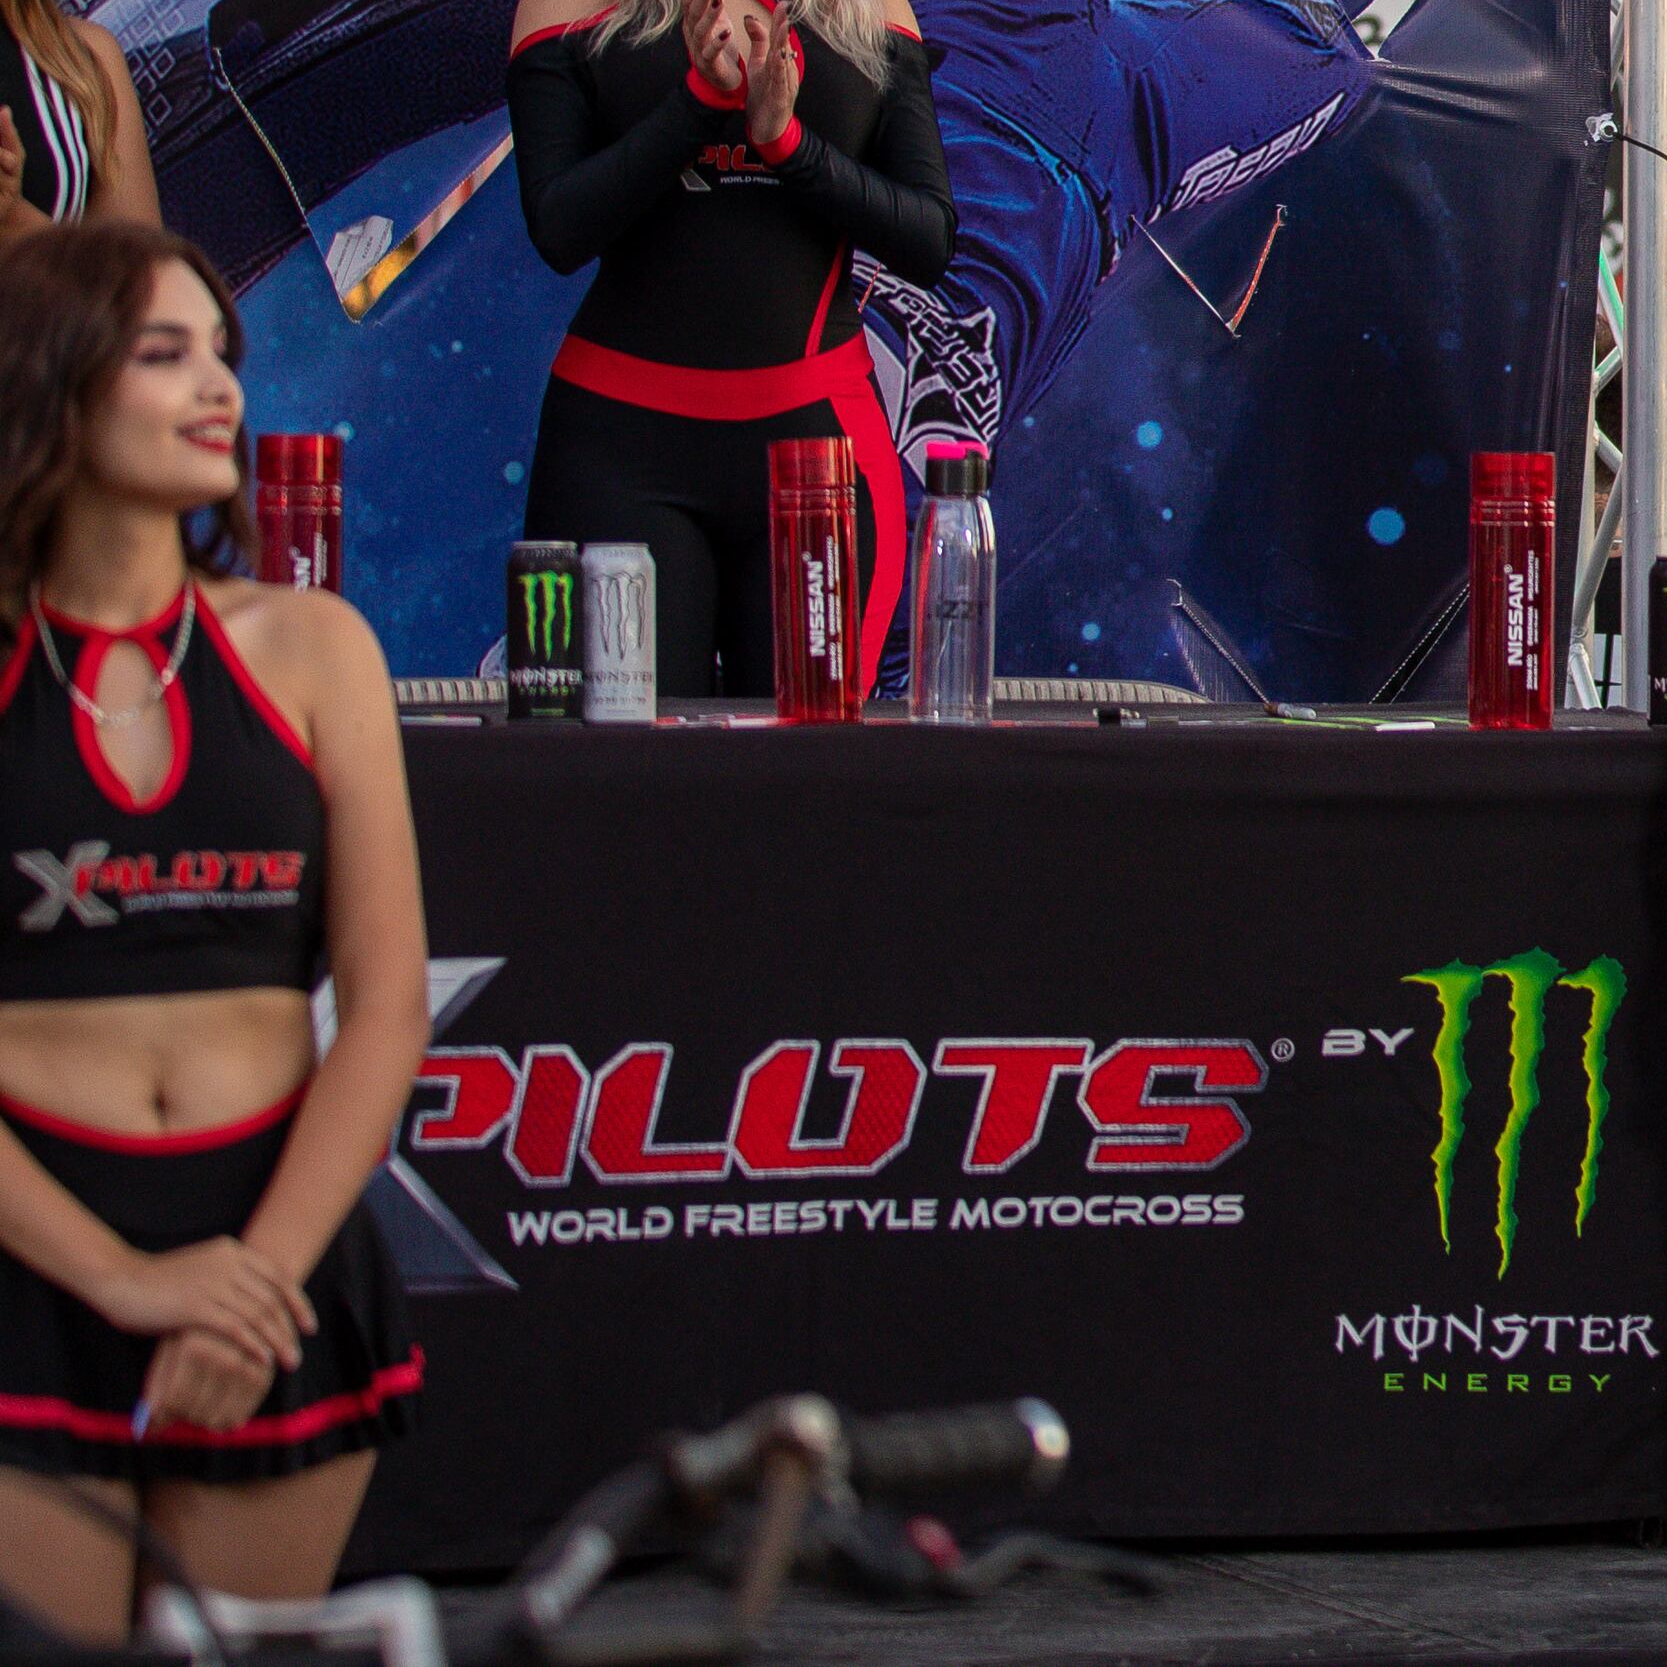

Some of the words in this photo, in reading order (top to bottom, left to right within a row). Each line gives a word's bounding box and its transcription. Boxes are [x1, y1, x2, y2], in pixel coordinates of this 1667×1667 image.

[808, 561, 826, 657] NISSAN
[1508, 573, 1524, 667] NISSAN
[1321, 1027, 1414, 1056] BY
[507, 1205, 672, 1246] WORLD
[683, 1197, 939, 1235] FREESTYLE
[949, 1193, 1245, 1230] MOTOCROSS
[1334, 1303, 1660, 1362] MONSTER
[1383, 1372, 1611, 1394] ENERGY
